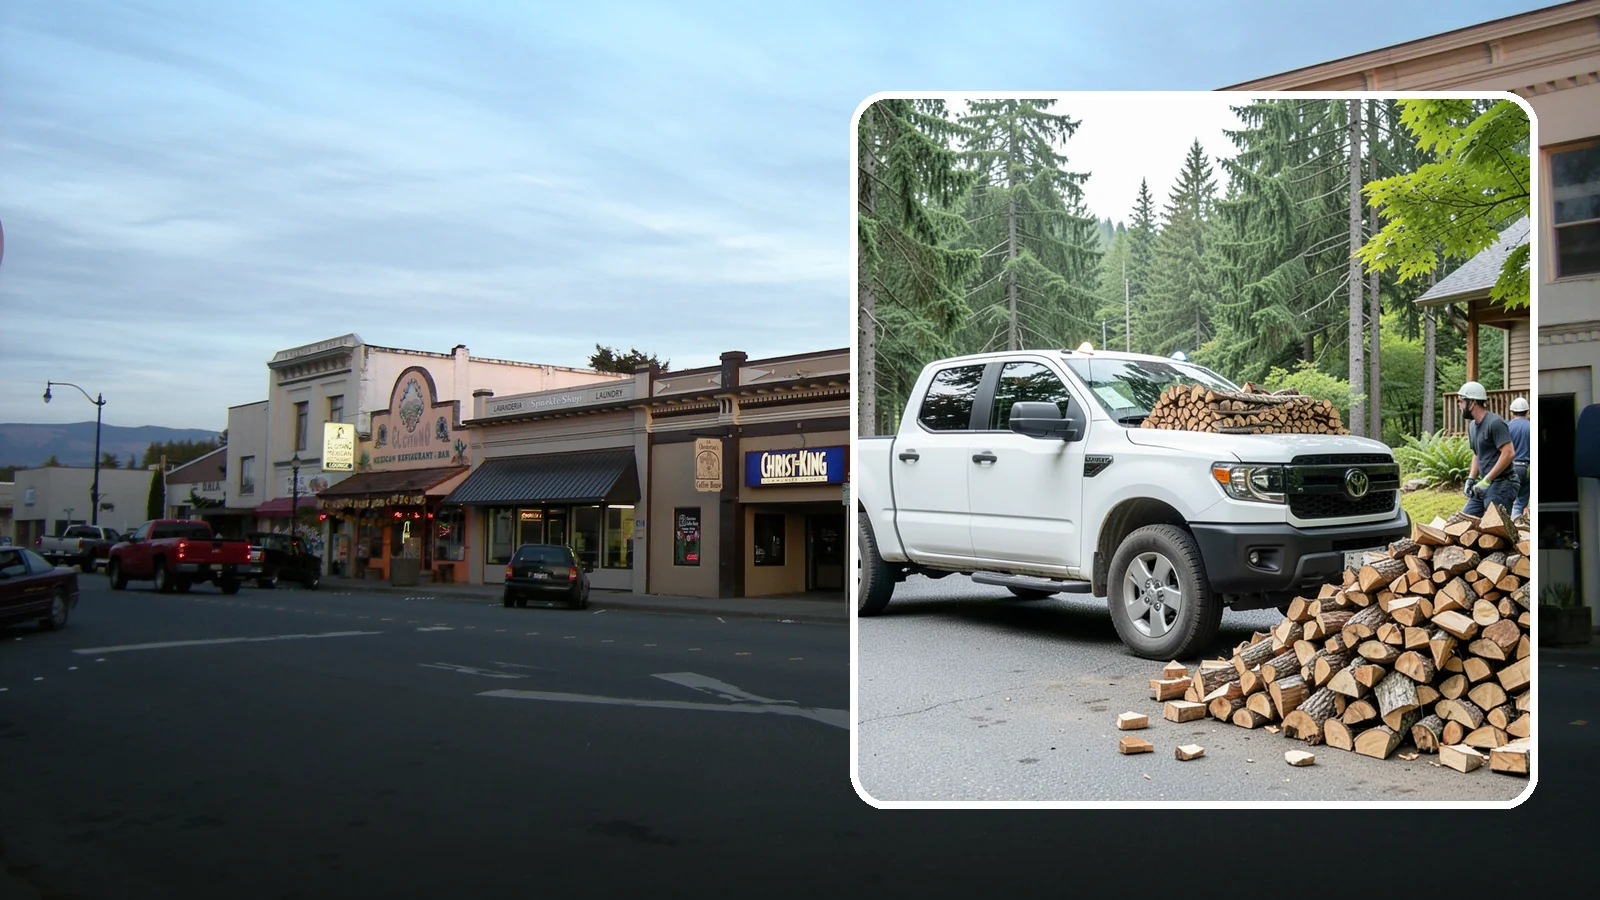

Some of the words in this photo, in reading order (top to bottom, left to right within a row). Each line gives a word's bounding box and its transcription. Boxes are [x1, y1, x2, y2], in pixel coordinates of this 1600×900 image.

[595, 389, 623, 400] LAUNDRY
[531, 396, 560, 410] Sparkle
[562, 393, 582, 406] Shop
[494, 402, 522, 413] LAVANDERIA
[327, 449, 352, 457] MEXICAN
[374, 455, 396, 464] MEXICAN
[397, 452, 433, 462] RESTAURANT
[438, 450, 450, 459] BAR
[761, 452, 797, 478] CHRIST
[799, 450, 827, 476] KING
[696, 481, 709, 489] Coffee
